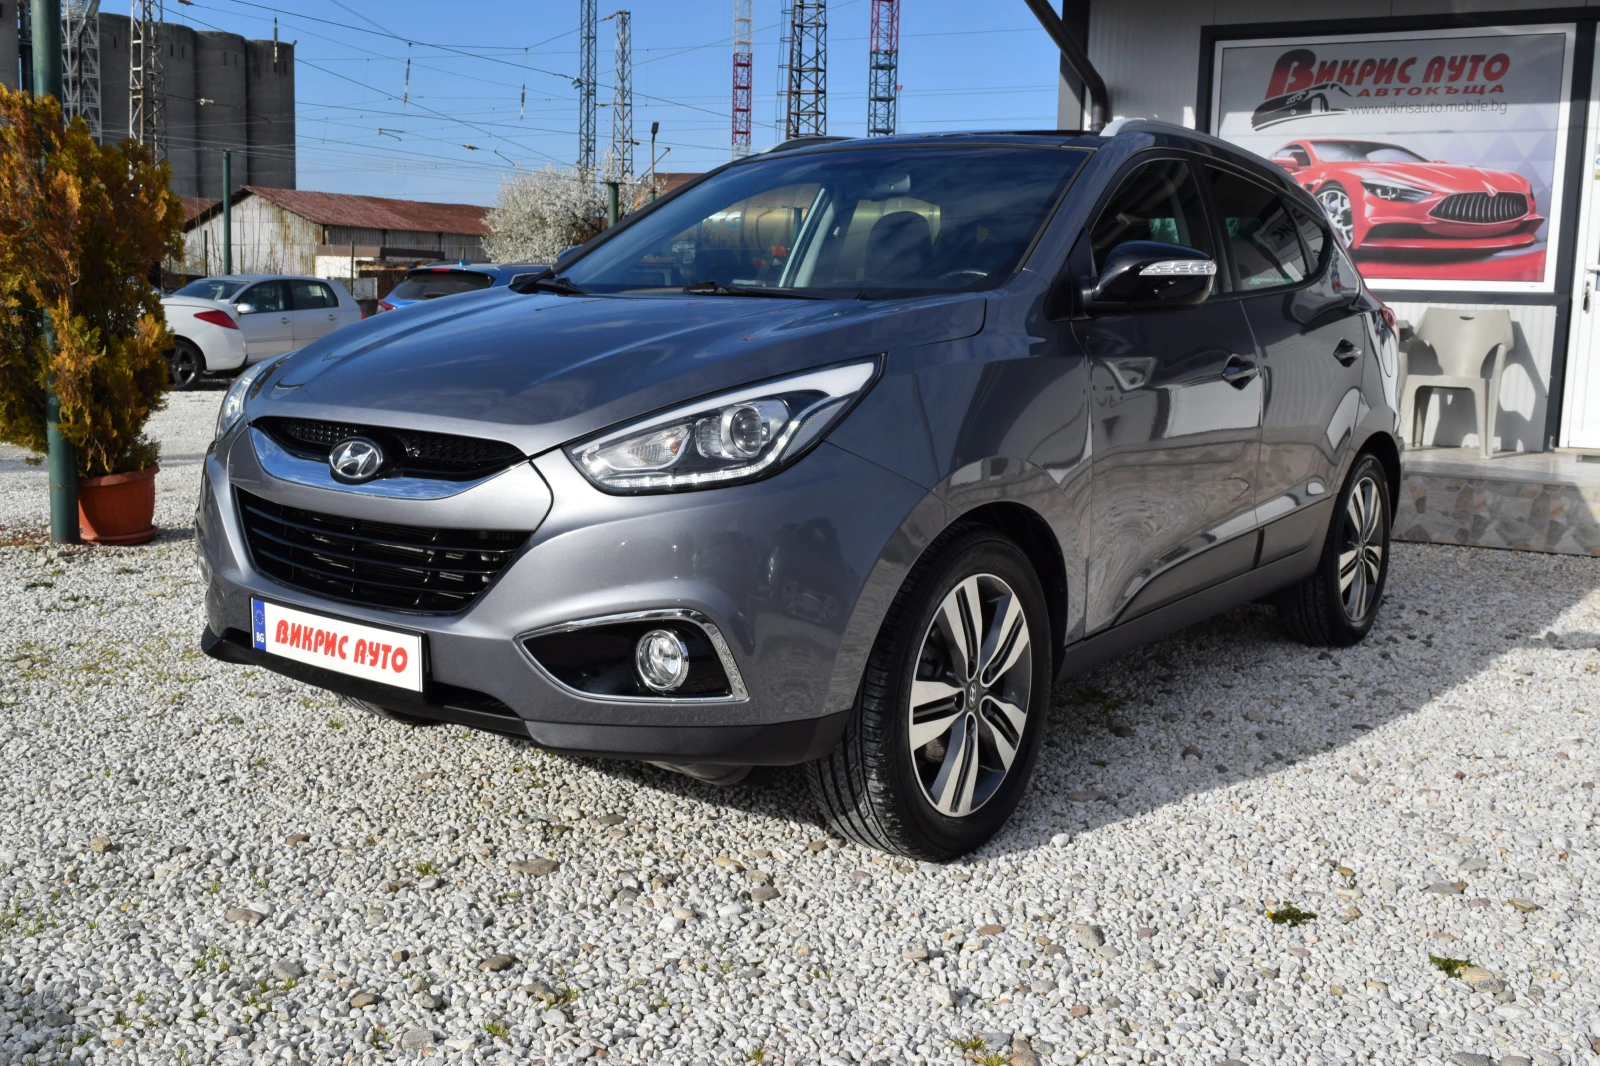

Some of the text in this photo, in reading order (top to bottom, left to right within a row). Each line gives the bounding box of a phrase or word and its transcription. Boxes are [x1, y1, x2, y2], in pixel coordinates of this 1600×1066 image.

[1355, 84, 1505, 98] АВТОКЪЩА
[1350, 99, 1508, 115] www.vikrisauto.mobile.bg
[256, 631, 265, 643] BG
[275, 619, 408, 673] ВИКРИС АУТО
